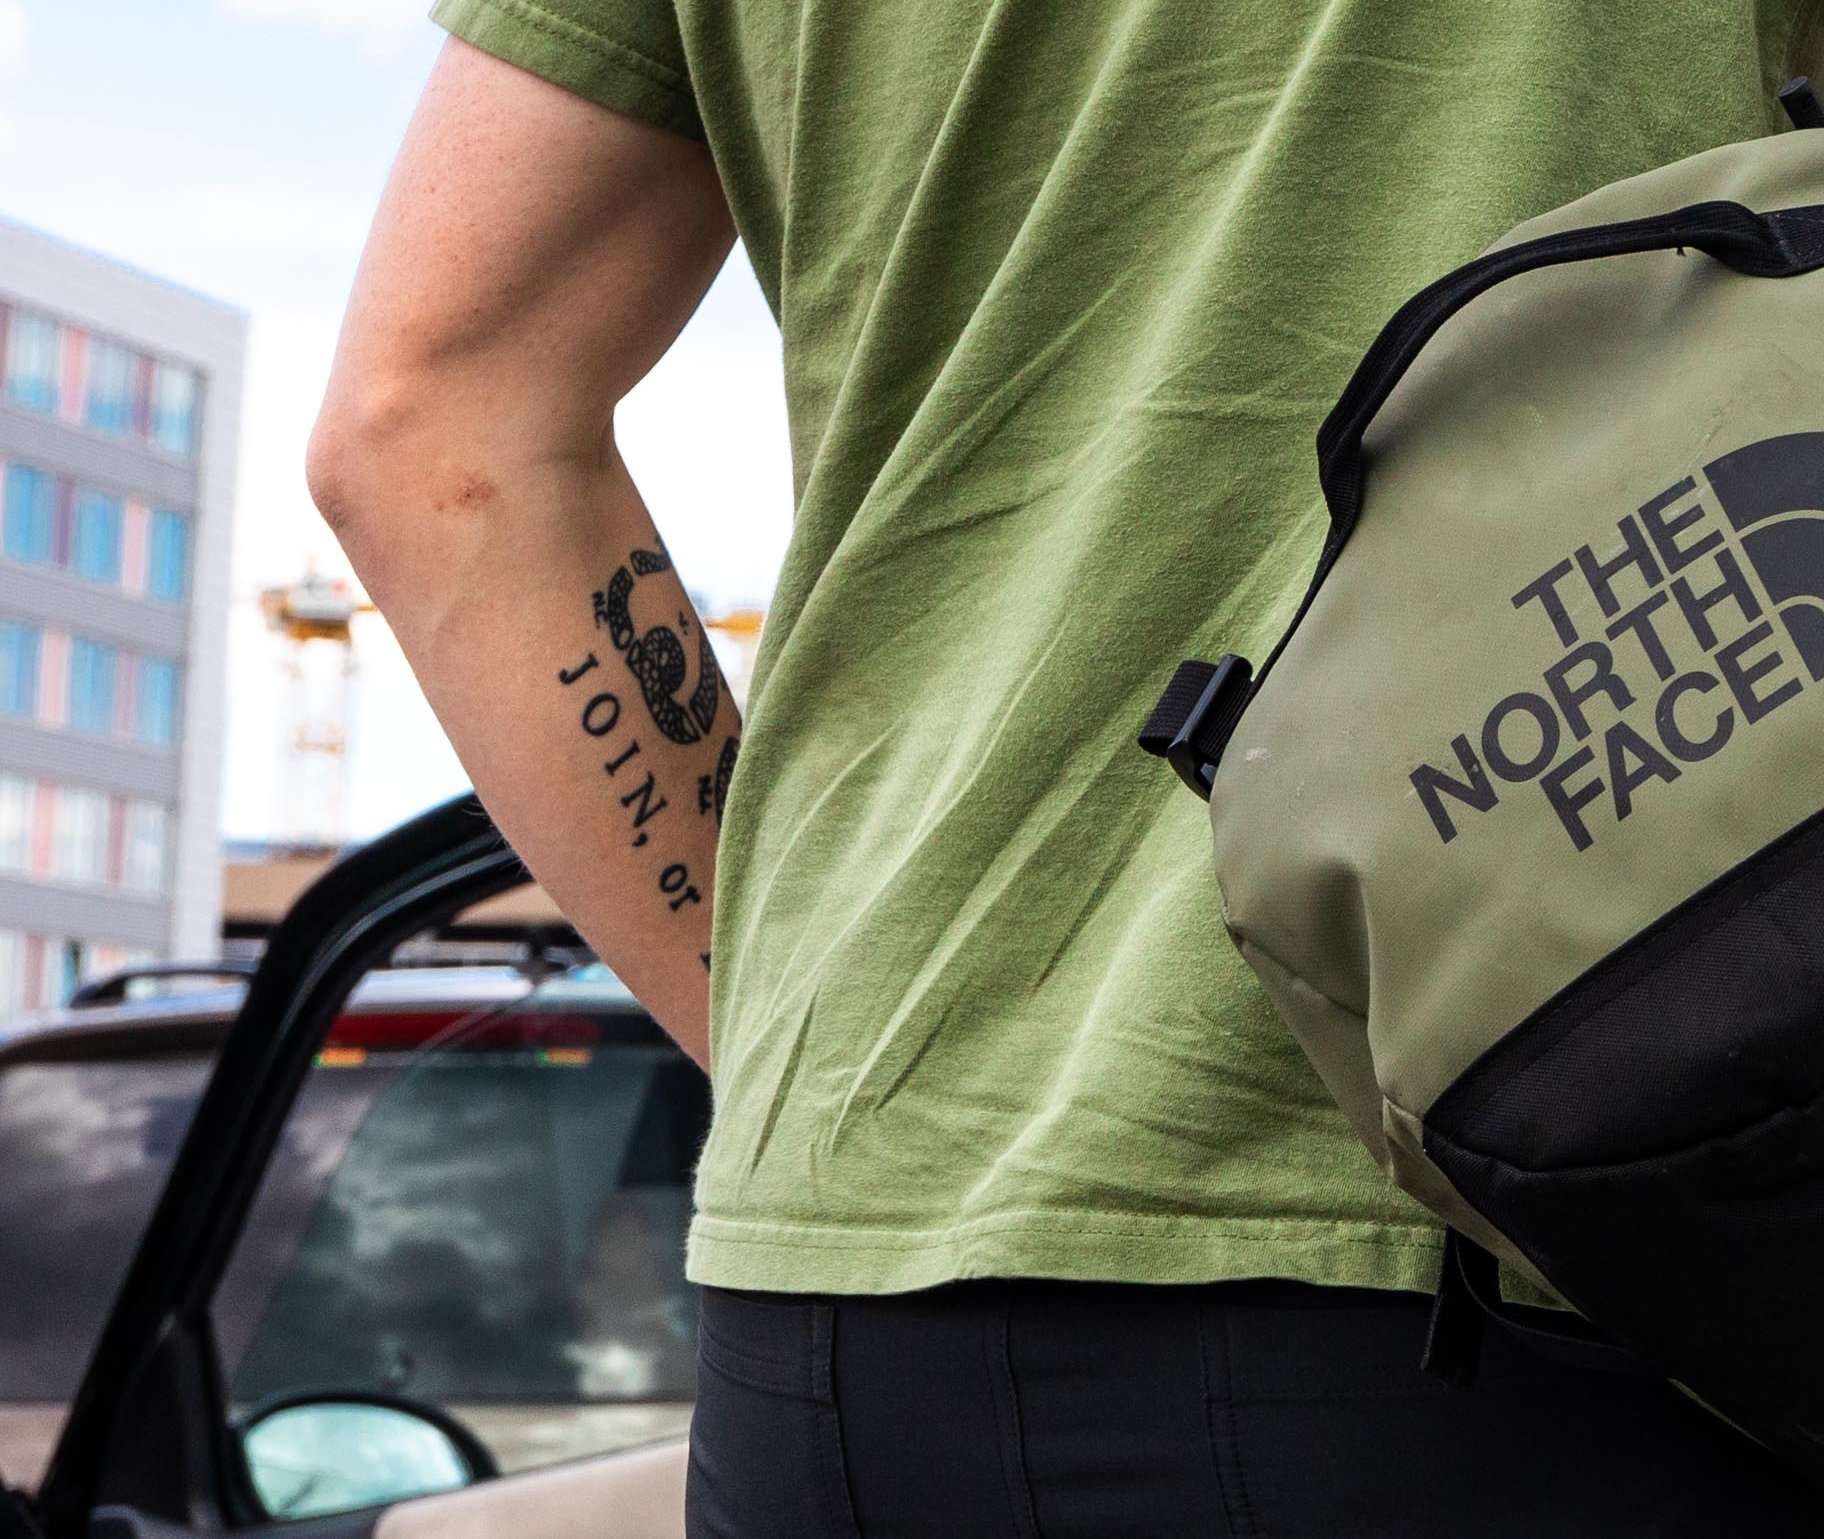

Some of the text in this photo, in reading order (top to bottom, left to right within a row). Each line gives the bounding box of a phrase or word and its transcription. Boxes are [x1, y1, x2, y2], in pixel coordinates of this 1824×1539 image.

[1511, 474, 1725, 648] THE
[558, 652, 701, 912] JOIN, or
[1408, 547, 1763, 844] NORTH
[1539, 619, 1804, 853] FACE
